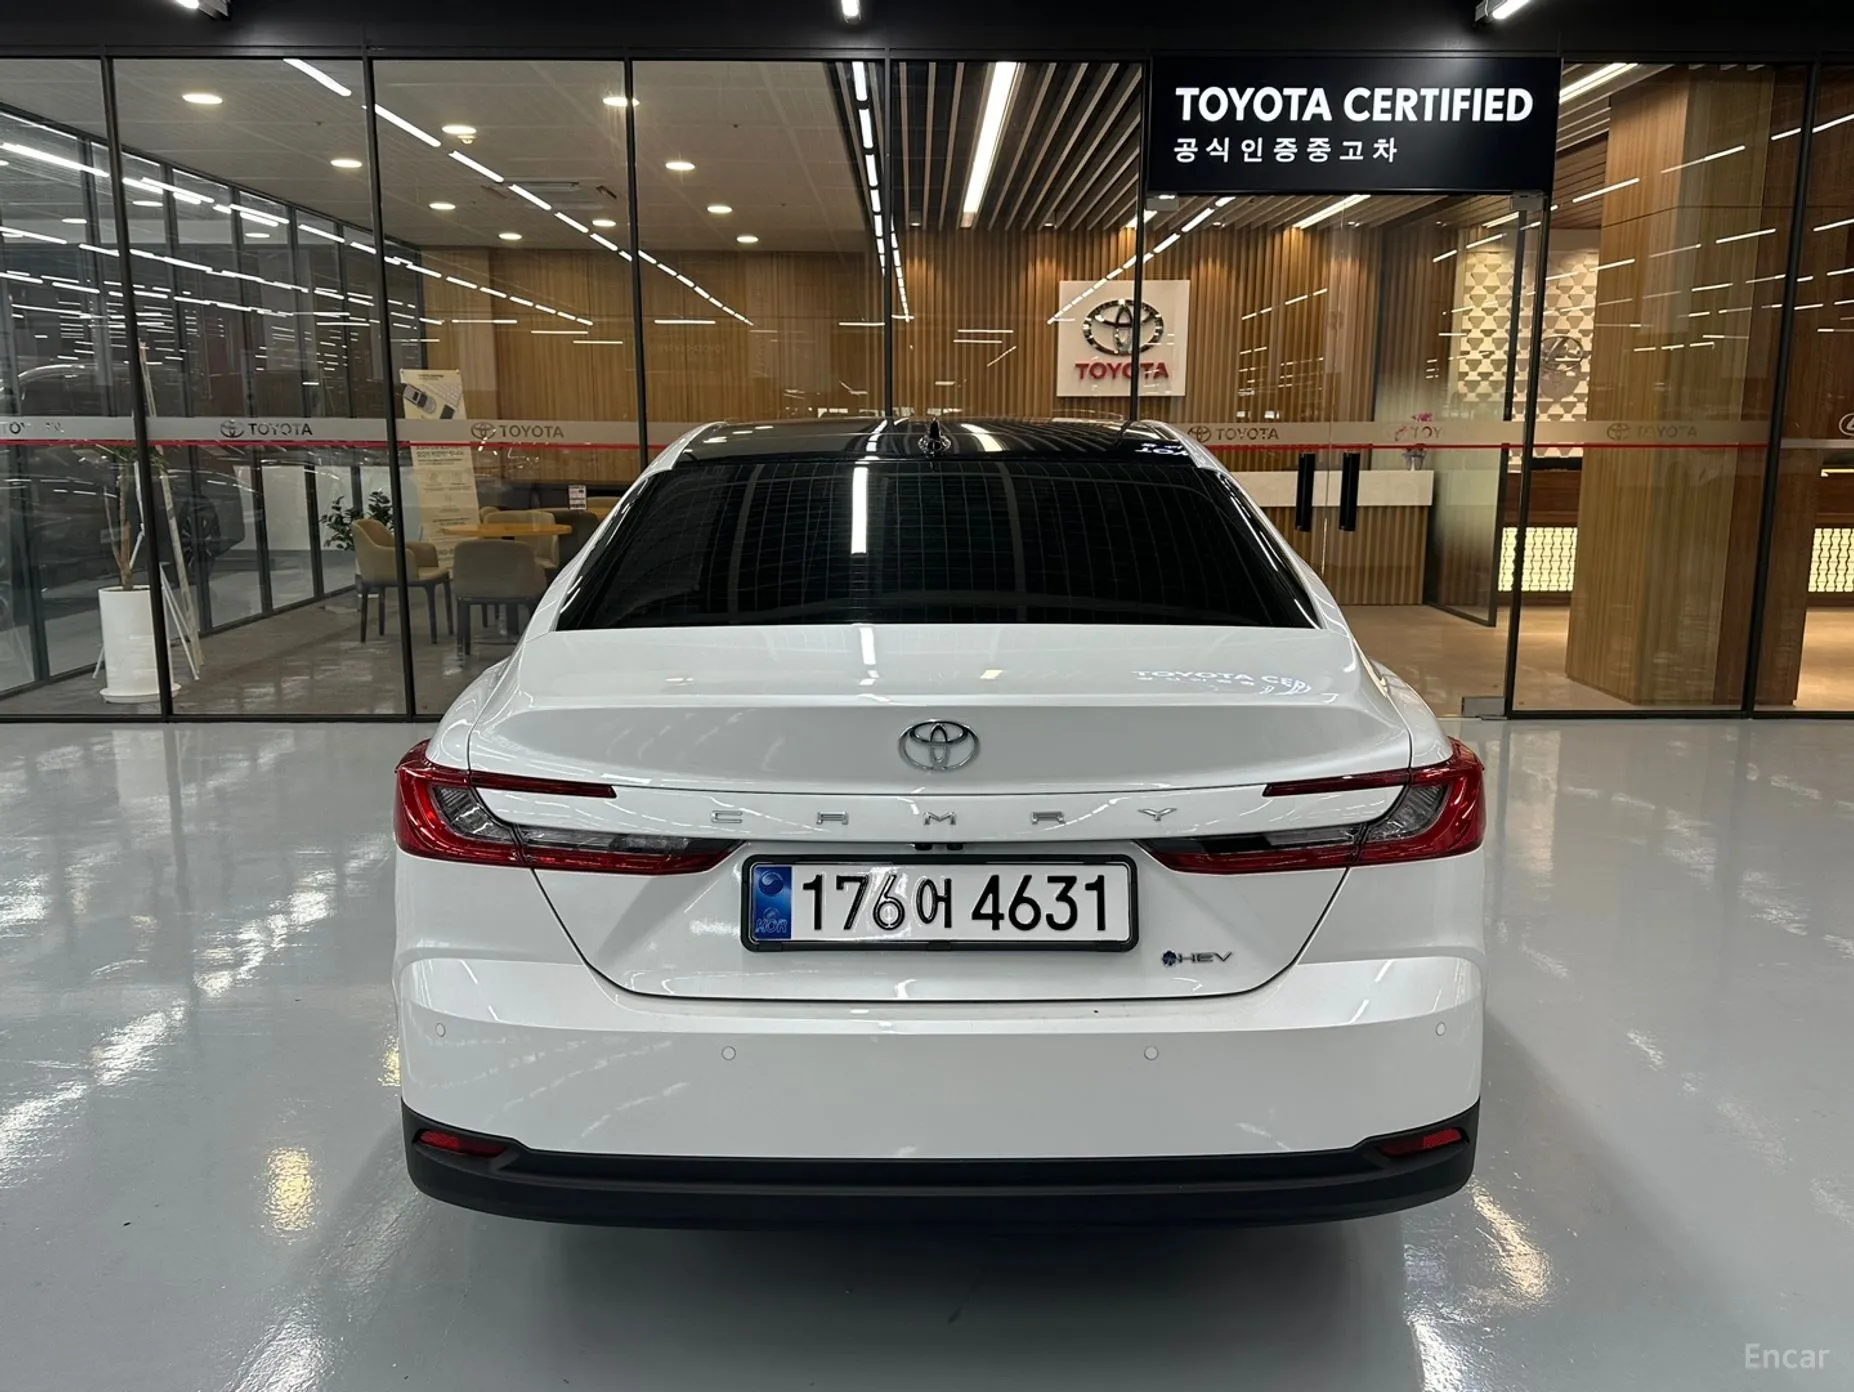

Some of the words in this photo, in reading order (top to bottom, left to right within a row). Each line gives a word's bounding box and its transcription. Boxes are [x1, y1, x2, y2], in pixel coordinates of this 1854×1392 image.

[1175, 86, 1333, 122] TOYOTA
[1343, 87, 1534, 122] CERTIFIED
[1174, 137, 1398, 163] 공식인증중고차
[248, 423, 313, 436] TOYOTA
[498, 424, 564, 438] TOYOTA
[1216, 427, 1279, 440] TOYOTA
[711, 807, 1178, 825] CAMRY
[802, 873, 953, 931] 176어
[971, 874, 1107, 931] 4631
[1178, 951, 1233, 963] HEV
